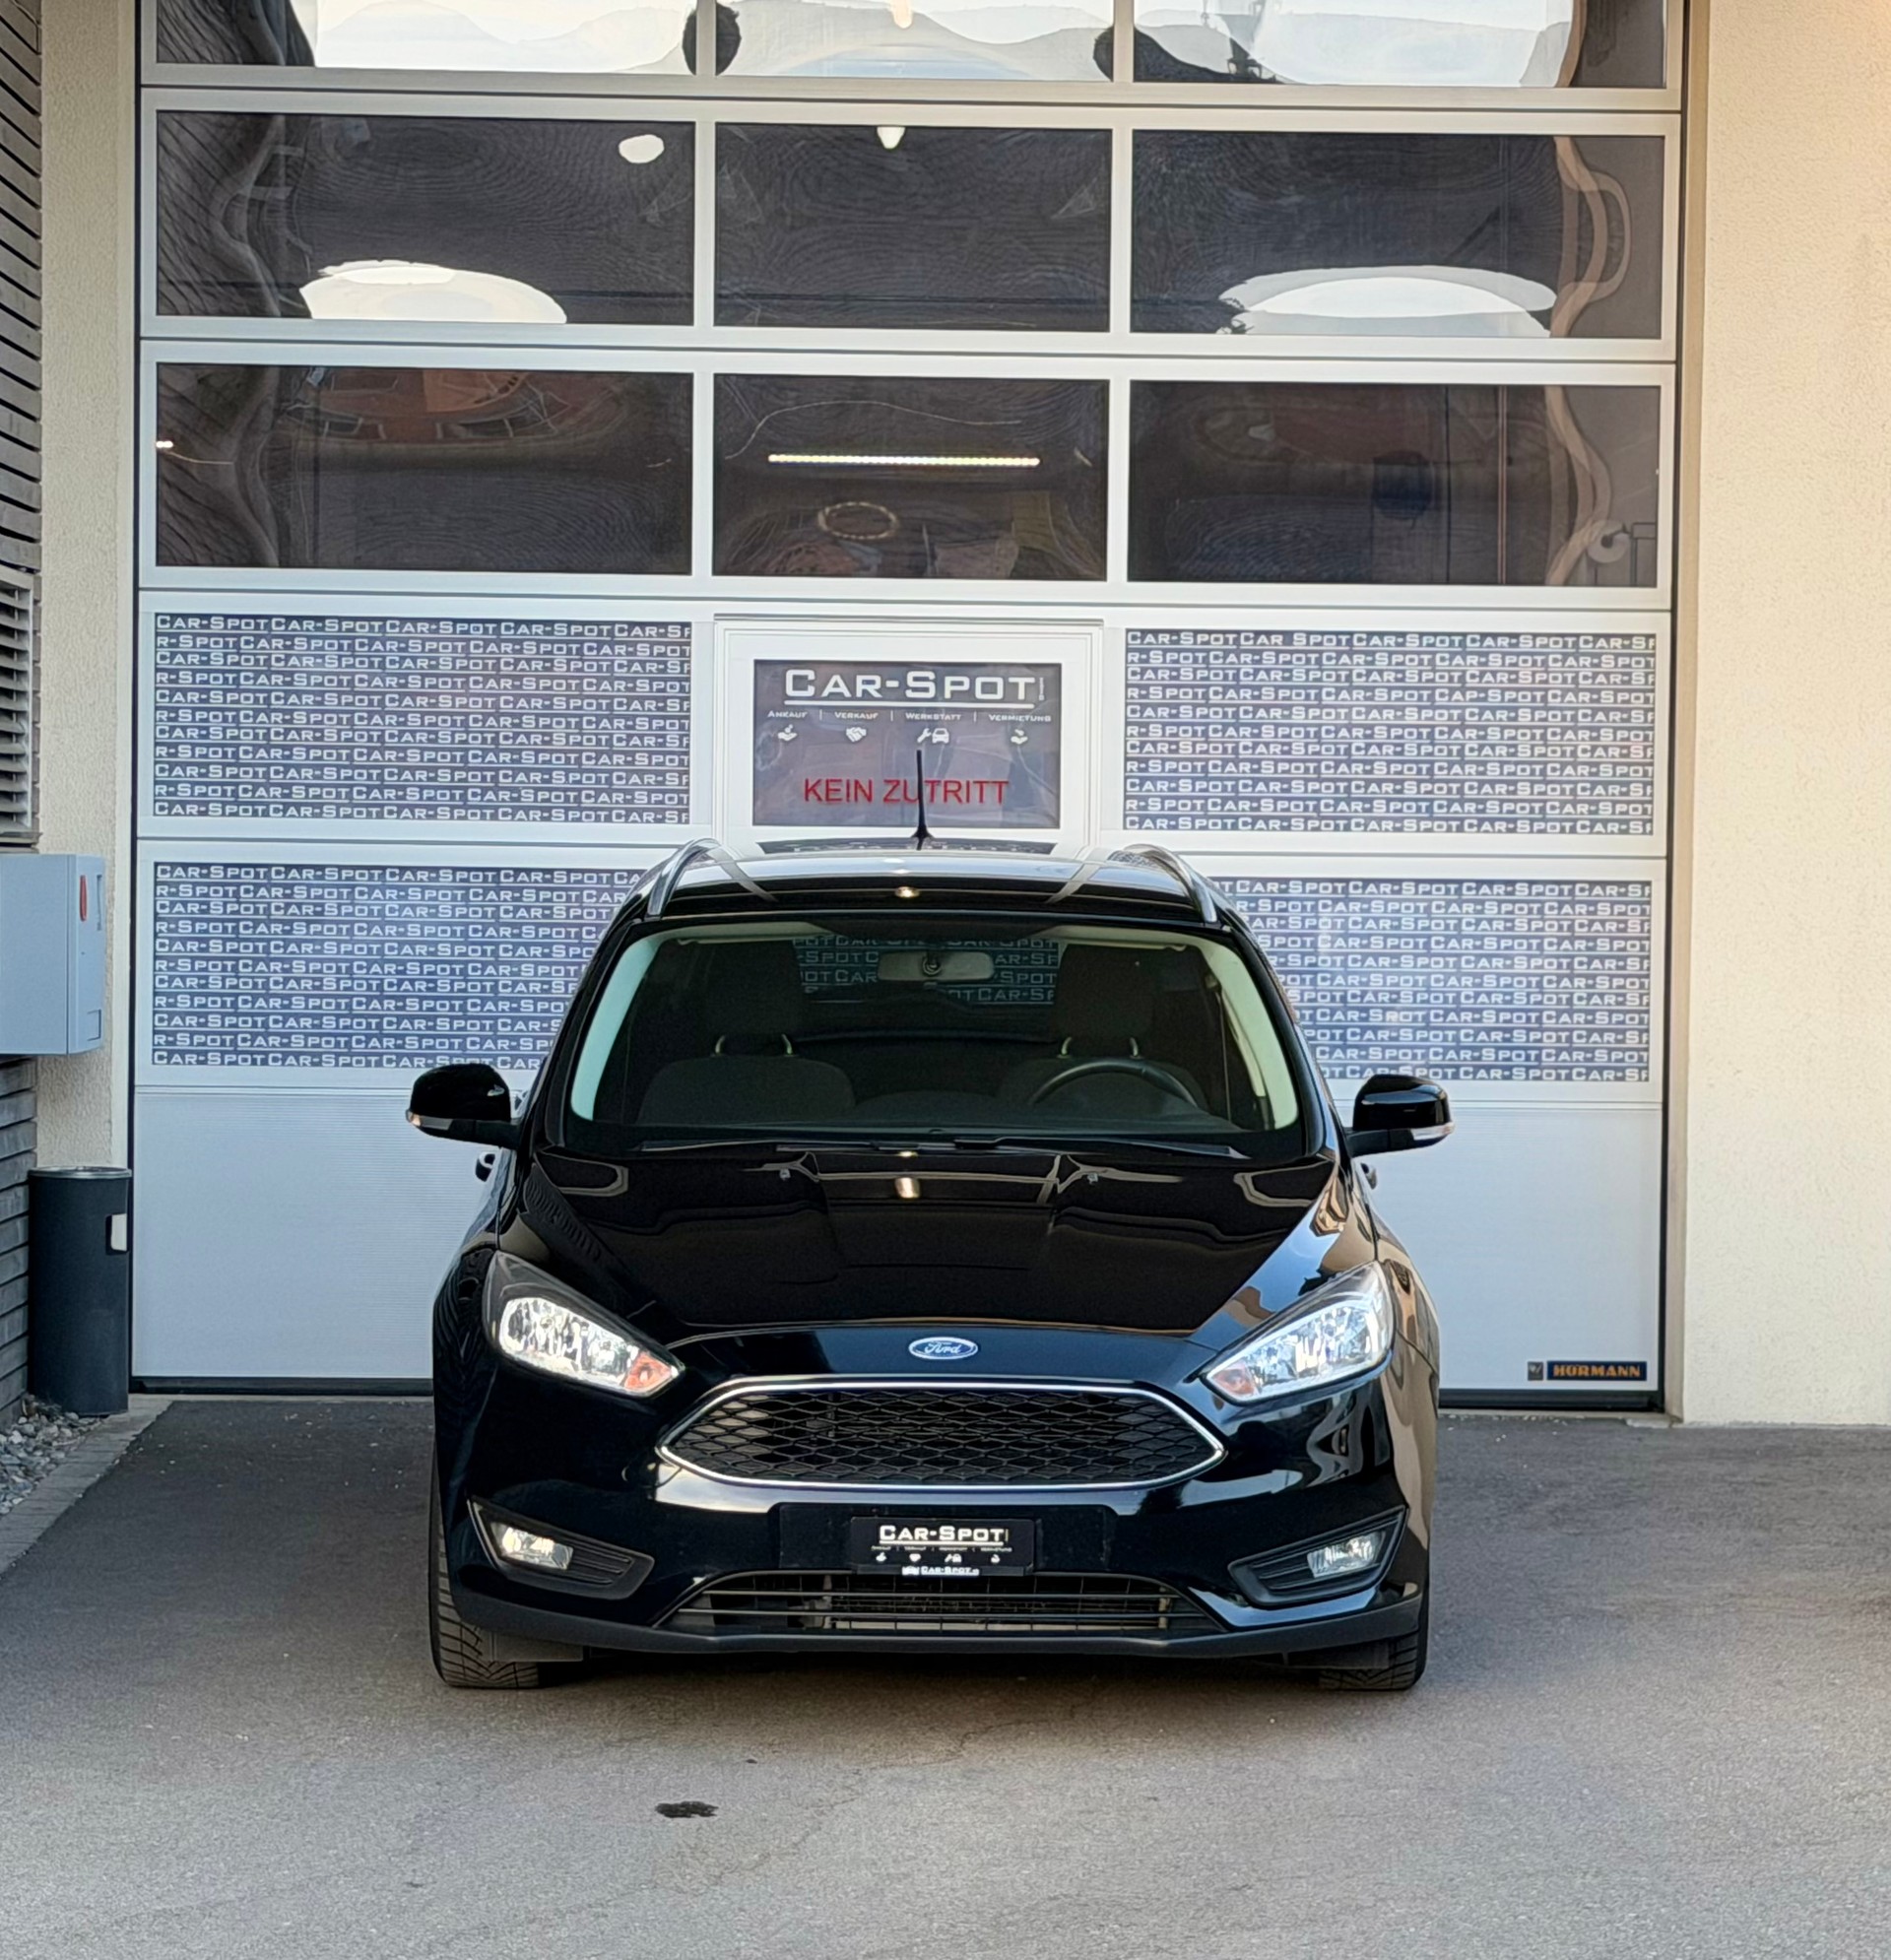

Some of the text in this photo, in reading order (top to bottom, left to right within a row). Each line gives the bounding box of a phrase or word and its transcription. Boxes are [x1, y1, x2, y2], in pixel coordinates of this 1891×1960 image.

[157, 616, 612, 636] CAR-SPOT CAR-SPOT CAR-SPOT CAR-SPOT
[239, 636, 580, 655] CAR-SPOT CAR-SPOT CAR-SPOT
[1128, 632, 1237, 645] CAR-SPOT
[1353, 634, 1463, 647] CAR-SPOT
[1466, 635, 1576, 648] CAR-SPOT
[157, 651, 612, 673] CAR-SPOT CAR-SPOT CAR-SPOT CAR-SPOT
[1209, 652, 1544, 667] CAR-SPOT CAR-SPOT CAR-SPOT
[239, 673, 579, 691] CAR-SPOT CAR-SPOT CAR-SPOT
[785, 670, 1035, 700] CAR-SPOT
[1127, 668, 1575, 685] CAR-SPOT CAR-SPOT CAR-SPOT CAR-SPOT
[156, 689, 611, 711] CAR-SPOT CAR-SPOT CAR-SPOT CAR-SPOT
[1208, 686, 1319, 700] CAR-SPOT
[1322, 687, 1431, 701] CAR-SPOT
[239, 710, 579, 729] CAR-SPOT CAR-SPOT CAR-SPOT
[834, 711, 879, 720] VERKAUF
[1127, 705, 1575, 722] CAR-SPOT CAR-SPOT CAR-SPOT CAR-SPOT
[156, 726, 611, 747] CAR-SPOT CAR-SPOT CAR-SPOT CAR-SPOT
[1208, 725, 1543, 741] CAR-SPOT CAR-SPOT CAR-SPOT
[238, 747, 579, 765] CAR-SPOT CAR-SPOT CAR-SPOT
[1127, 741, 1575, 757] CAR-SPOT CAR-SPOT CAR-SPOT CAR-SPOT
[156, 764, 611, 785] CAR-SPOT CAR-SPOT CAR-SPOT CAR-SPOT
[1207, 760, 1543, 776] CAR-SPOT CAR-SPOT CAR-SPOT
[238, 785, 578, 804] CAR-SPOT CAR-SPOT CAR-SPOT
[804, 778, 1009, 804] KEIN ZUTRITT
[1126, 779, 1574, 796] CAR-SPOT CAR-SPOT CAR-SPOT CAR-SPOT
[155, 803, 610, 823] CAR-SPOT CAR-SPOT CAR-SPOT CAR-SPOT
[1207, 799, 1542, 814] CAR-SPOT CAR-SPOT CAR-SPOT
[1126, 817, 1574, 833] CAR-SPOT CAR-SPOT CAR-SPOT CAR-SPOT
[157, 866, 612, 884] CAR-SPOT CAR-SPOT CAR-SPOT CAR-SPOT
[239, 885, 580, 903] CAR-SPOT CAR-SPOT CAR-SPOT
[1236, 881, 1572, 896] CAR-SPOT CAR-SPOT CAR-SPOT
[157, 900, 612, 920] CAR-SPOT CAR-SPOT CAR-SPOT CAR-SPOT
[1318, 899, 1428, 913] CAR-SPOT
[1431, 900, 1541, 914] CAR-SPOT
[239, 921, 579, 939] CAR-SPOT CAR-SPOT CAR-SPOT
[1348, 917, 1572, 931] CAR-SPOT CAR-SPOT
[156, 939, 496, 956] CAR-SPOT CAR-SPOT CAR-SPOT
[1431, 937, 1540, 950] CAR-SPOT
[238, 959, 579, 977] CAR-SPOT CAR-SPOT CAR-SPOT
[1348, 954, 1571, 969] CAR-SPOT CAR-SPOT
[156, 975, 495, 993] CAR-SPOT CAR-SPOT CAR-SPOT
[1317, 974, 1427, 988] CAR-SPOT
[1430, 975, 1540, 989] CAR-SPOT
[238, 996, 464, 1012] CAR-SPOT CAR-SPOT
[1347, 990, 1571, 1005] CAR-SPOT CAR-SPOT
[155, 1013, 494, 1031] CAR-SPOT CAR-SPOT CAR-SPOT
[1430, 1010, 1539, 1023] CAR-SPOT
[237, 1034, 463, 1050] CAR-SPOT CAR-SPOT
[1347, 1028, 1570, 1043] CAR-SPOT CAR-SPOT
[154, 1052, 380, 1068] CAR-SPOT CAR-SPOT
[1317, 1047, 1426, 1061] CAR-SPOT
[1429, 1048, 1539, 1062] CAR-SPOT
[1460, 1067, 1570, 1080] CAR-SPOT
[924, 1340, 962, 1354] Ford
[880, 1525, 1005, 1542] CAR-SPOT
